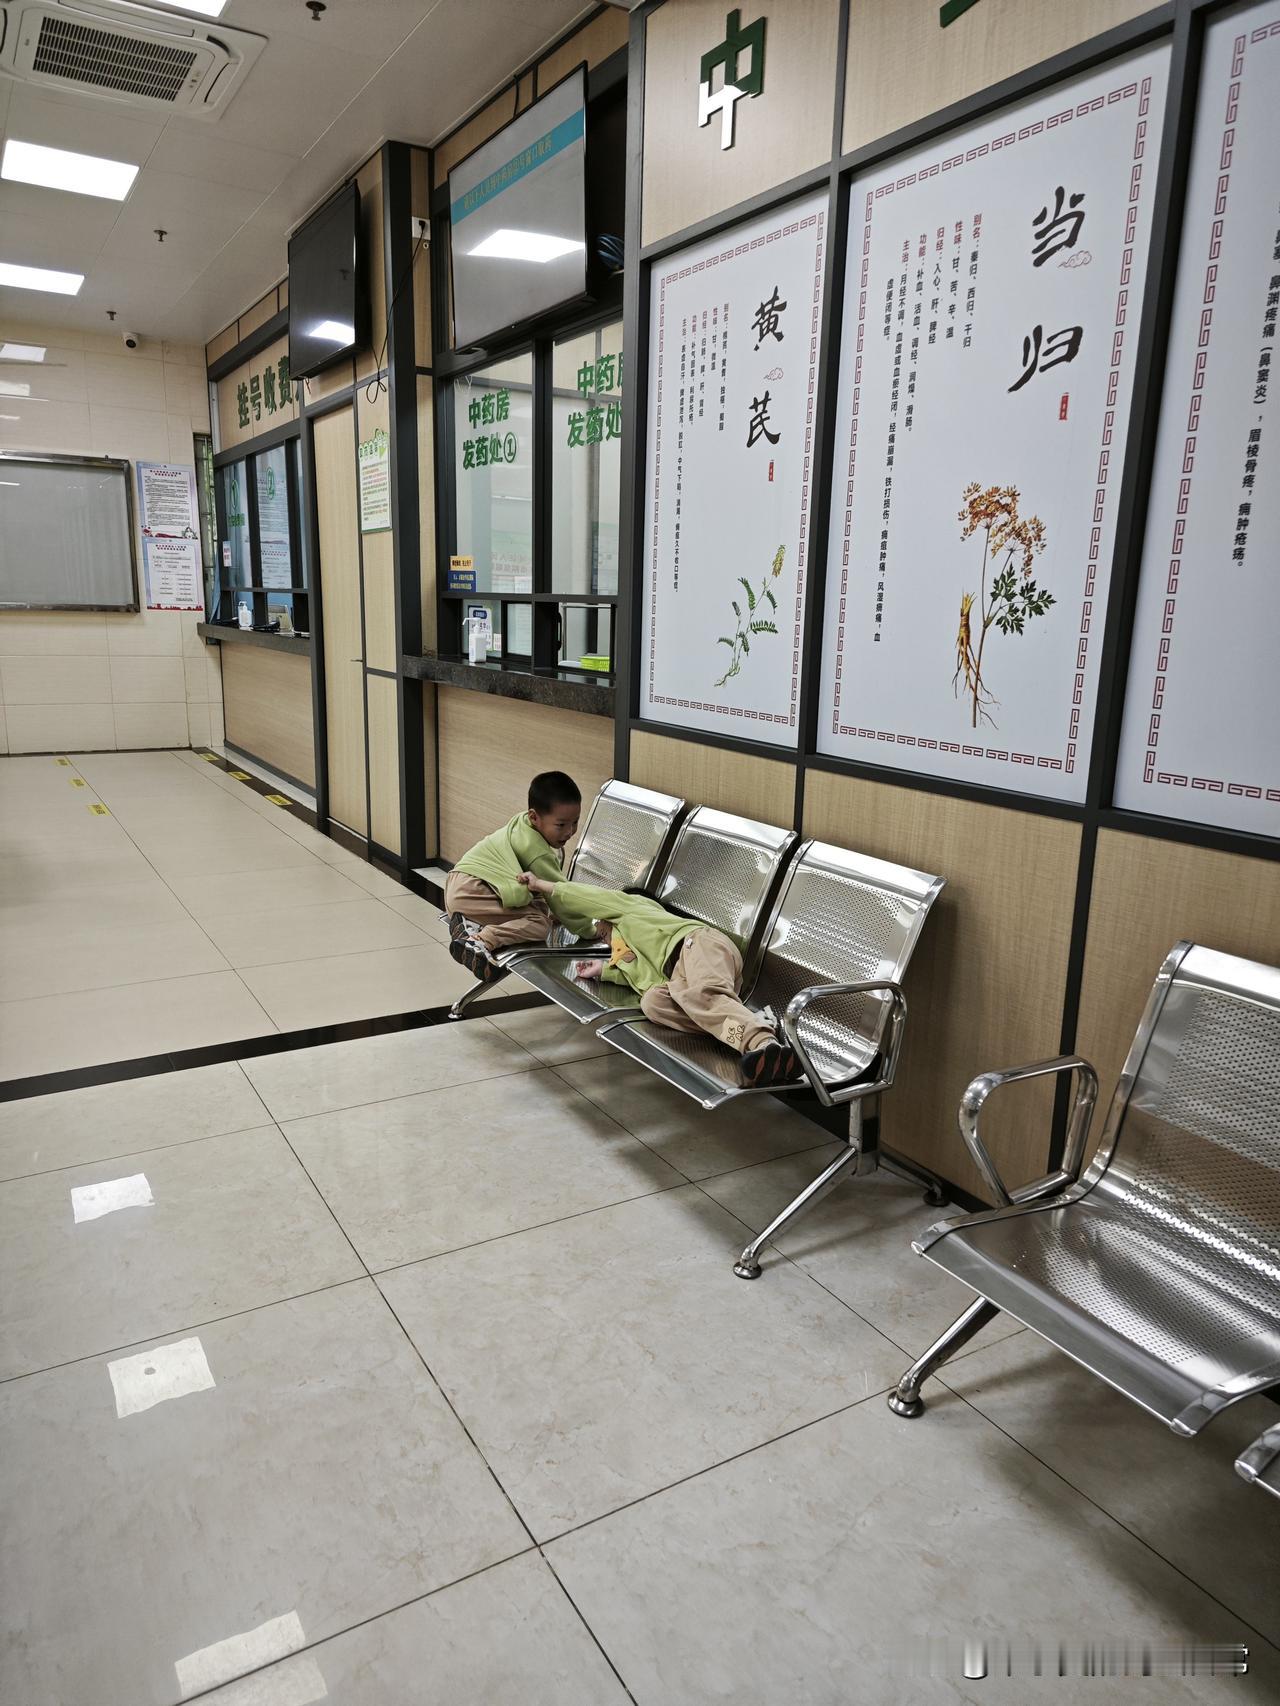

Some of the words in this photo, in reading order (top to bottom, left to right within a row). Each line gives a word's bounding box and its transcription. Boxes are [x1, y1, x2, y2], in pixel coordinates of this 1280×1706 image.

[698, 9, 768, 151] 中
[1007, 186, 1086, 393] 当归
[237, 355, 299, 429] 挂号收费
[468, 388, 511, 429] 中药房
[577, 352, 623, 398] 中药
[746, 285, 787, 448] 黄芪
